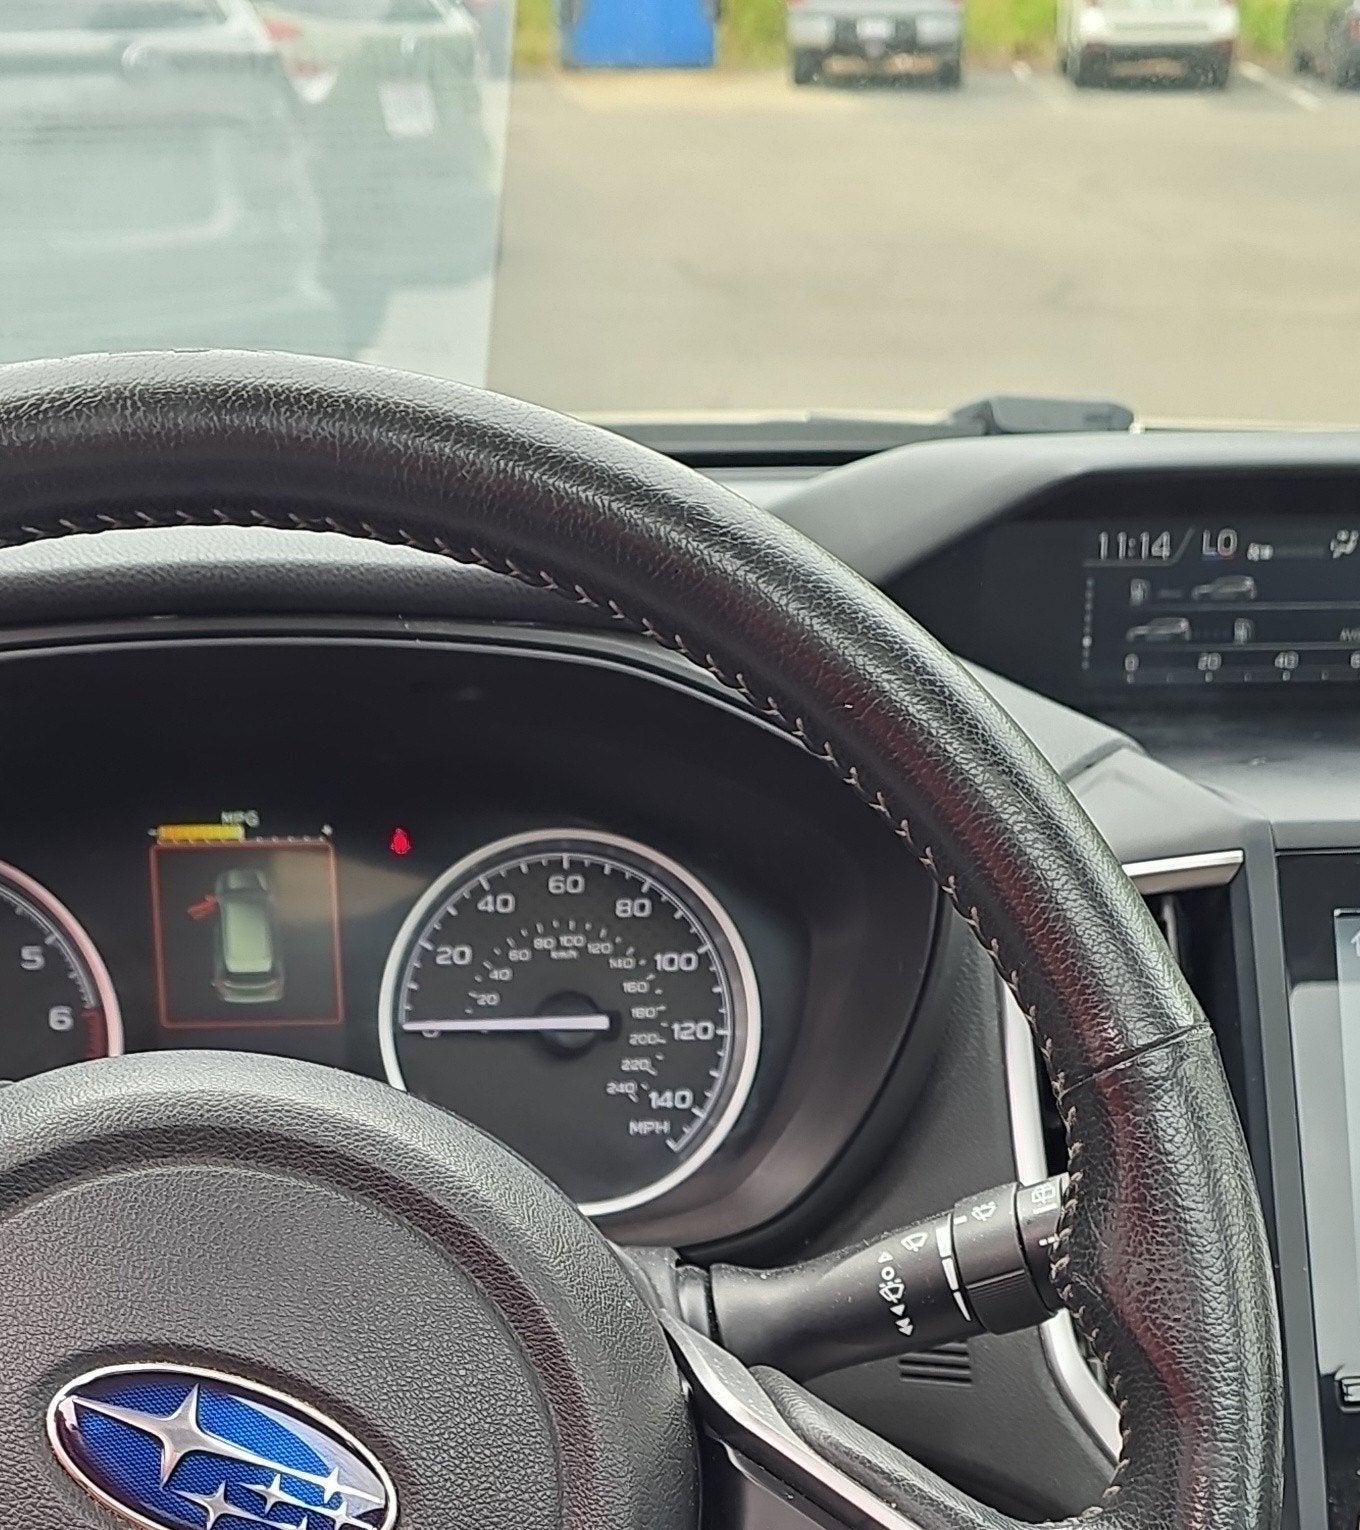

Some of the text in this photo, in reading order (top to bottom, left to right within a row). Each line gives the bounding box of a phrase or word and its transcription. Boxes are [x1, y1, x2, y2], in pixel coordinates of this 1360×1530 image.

[1098, 530, 1172, 561] 11:14
[1202, 528, 1238, 557] LO
[547, 874, 586, 895] 60
[476, 892, 516, 915] 40
[614, 898, 653, 919] 80
[558, 934, 586, 948] 100
[587, 941, 614, 955] 120
[20, 945, 45, 971] 5
[435, 944, 473, 966] 20
[508, 949, 532, 962] 60
[653, 952, 699, 972] 100
[489, 968, 513, 981] 40
[622, 980, 650, 994] 160
[48, 1006, 74, 1032] 6
[629, 1032, 658, 1046] 200
[670, 1021, 715, 1041] 120
[621, 1057, 652, 1071] 220
[606, 1080, 638, 1095] 240
[648, 1088, 694, 1110] 140
[628, 1119, 671, 1136] MPH
